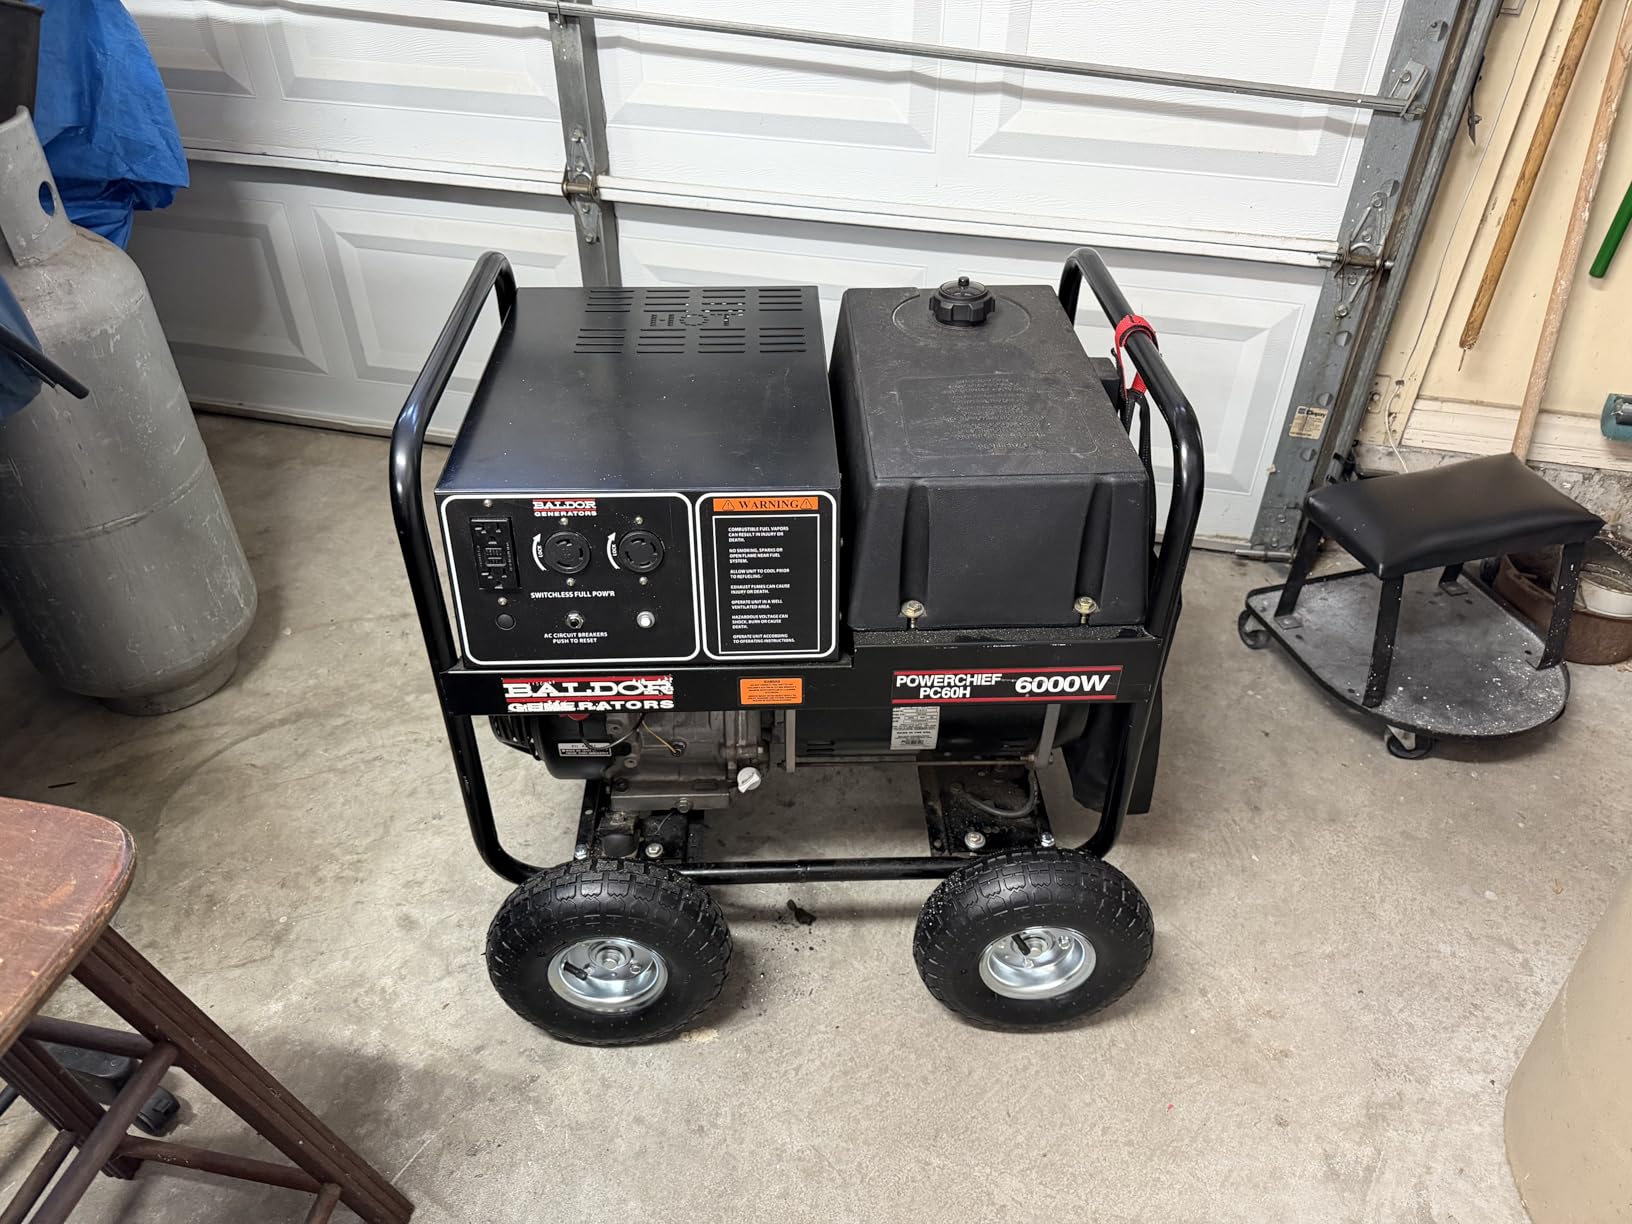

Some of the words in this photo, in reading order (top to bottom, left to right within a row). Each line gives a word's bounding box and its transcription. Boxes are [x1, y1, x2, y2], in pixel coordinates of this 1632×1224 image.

[738, 500, 798, 509] WARNING
[502, 681, 673, 698] BALDOR
[896, 674, 1002, 687] POWERCHIEF
[1014, 674, 1111, 693] 6000W
[919, 687, 971, 698] PC60H
